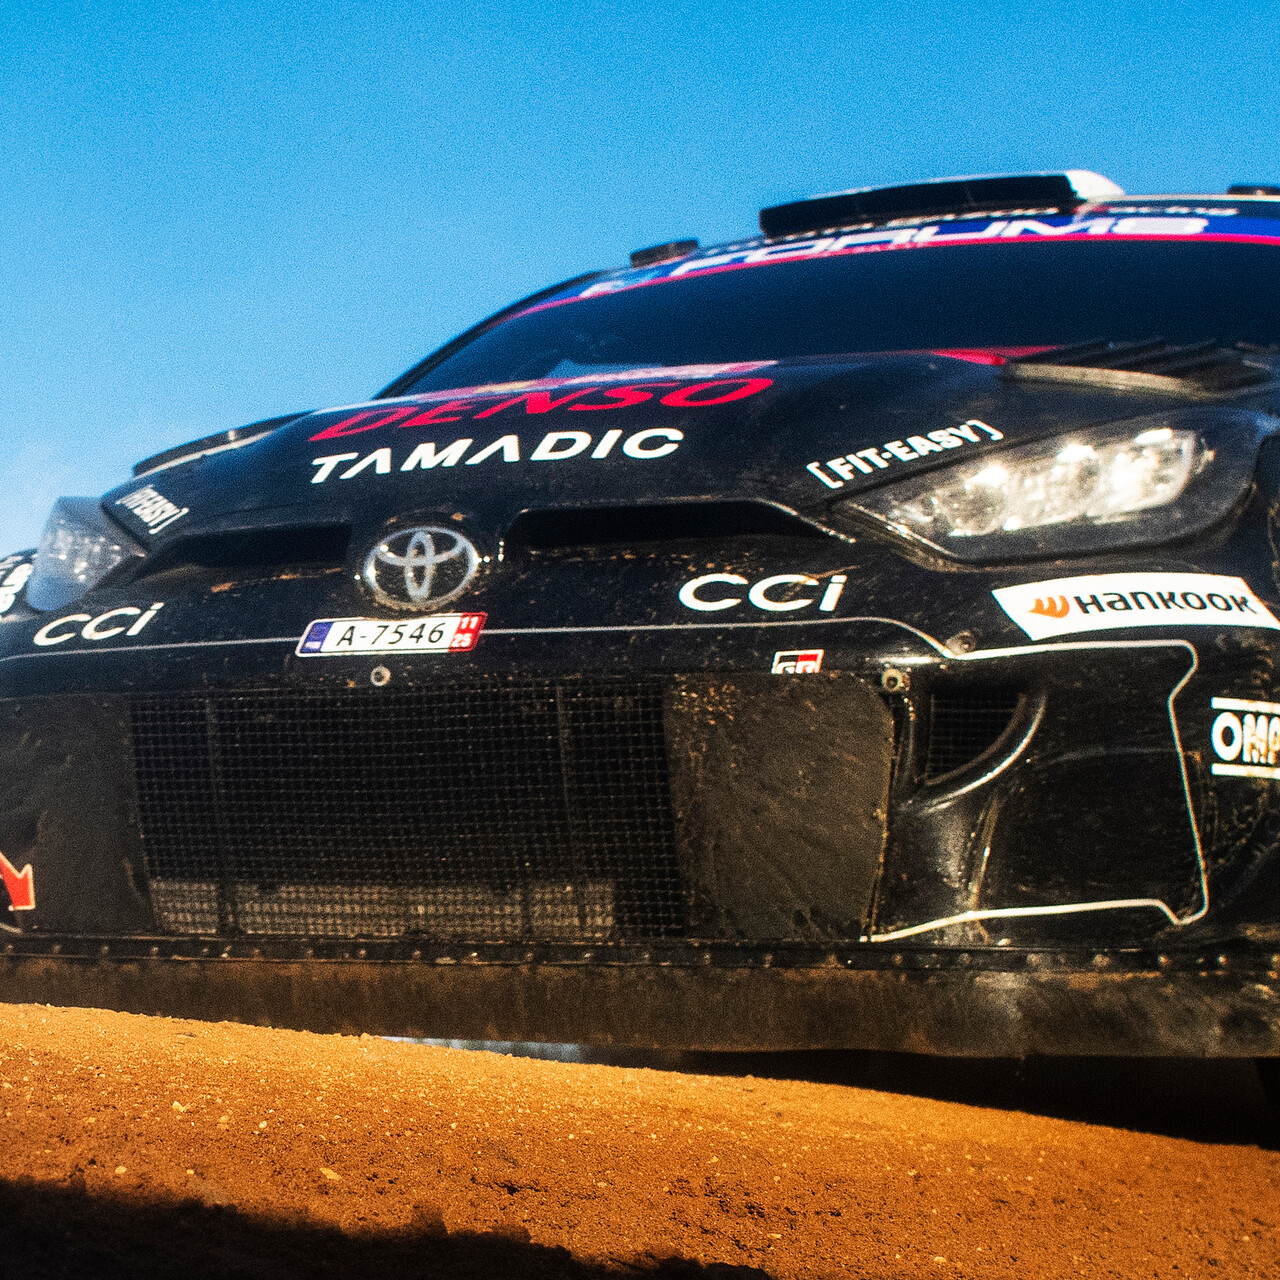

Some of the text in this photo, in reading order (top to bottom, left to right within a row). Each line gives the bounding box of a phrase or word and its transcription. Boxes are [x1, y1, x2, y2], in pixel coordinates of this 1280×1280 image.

[308, 377, 774, 442] DENSO
[311, 427, 685, 484] TAMADIC
[336, 622, 446, 647] A-7546
